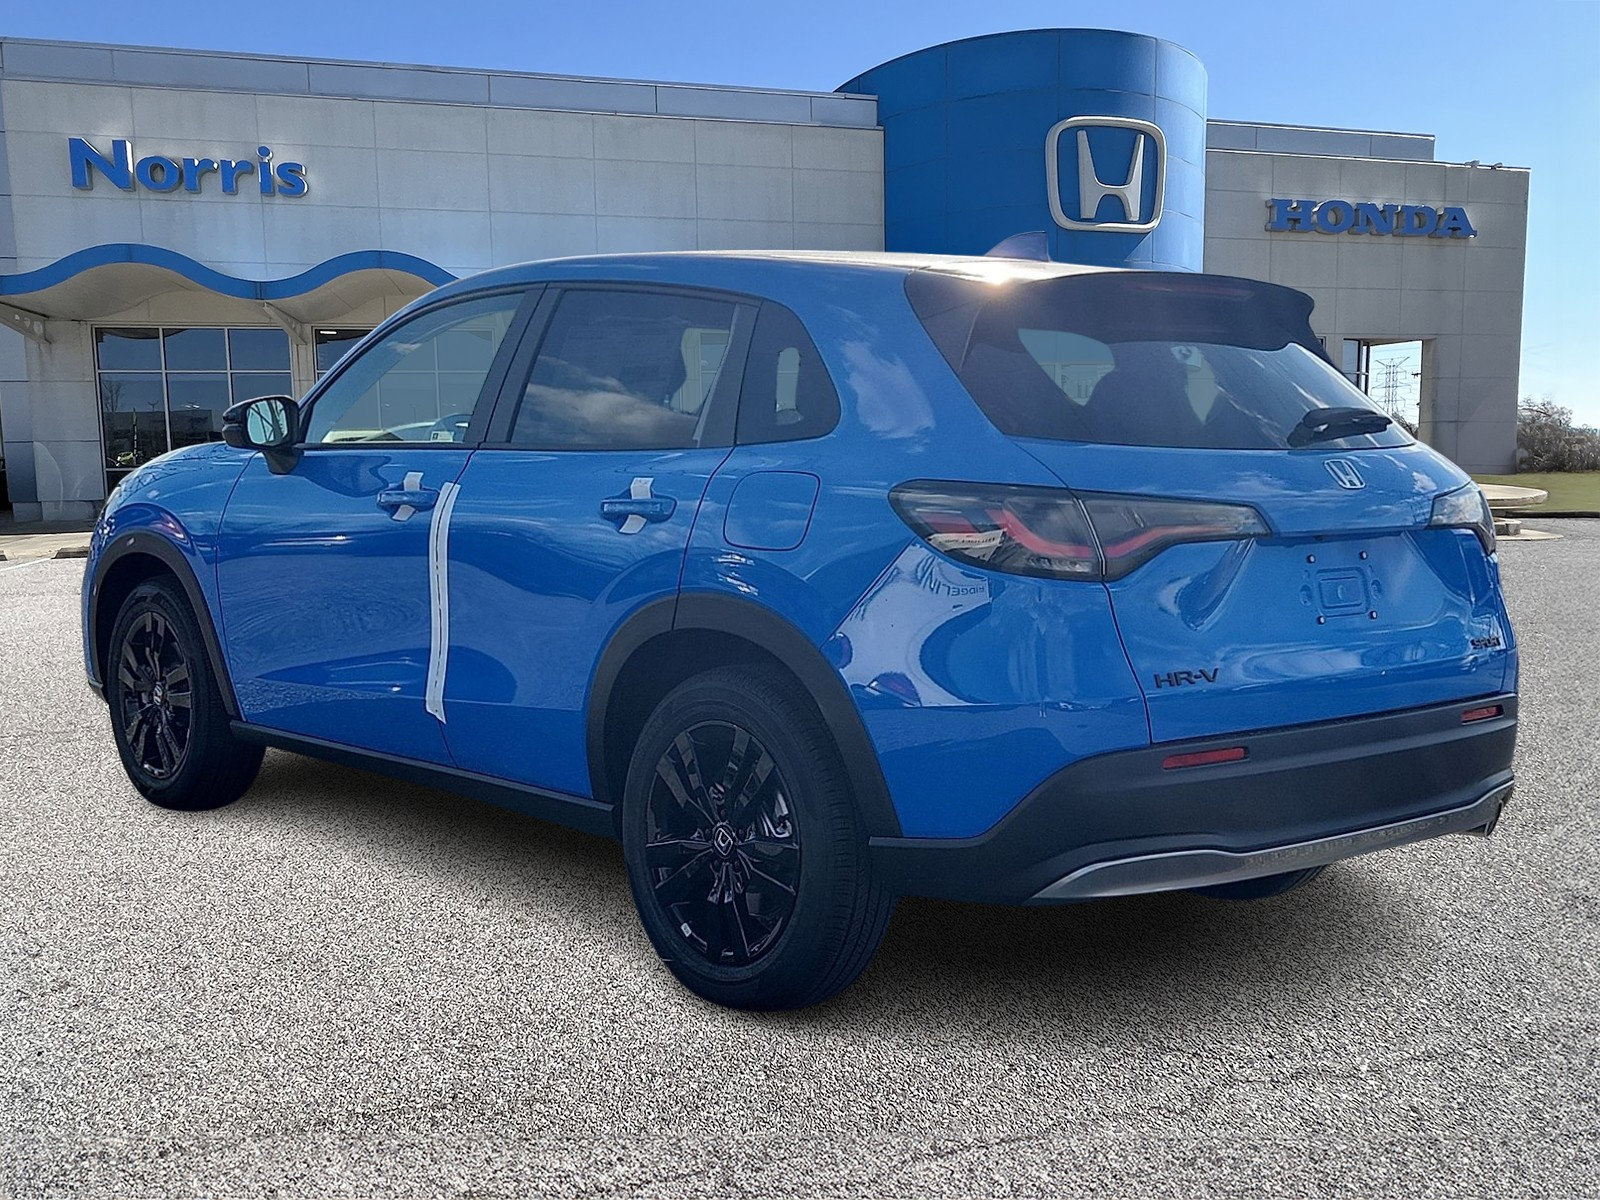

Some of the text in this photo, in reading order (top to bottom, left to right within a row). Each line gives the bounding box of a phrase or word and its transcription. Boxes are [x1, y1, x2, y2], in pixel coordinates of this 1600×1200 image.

[68, 137, 308, 197] Norris
[1265, 198, 1477, 239] HONDA
[1154, 667, 1219, 689] HR-V
